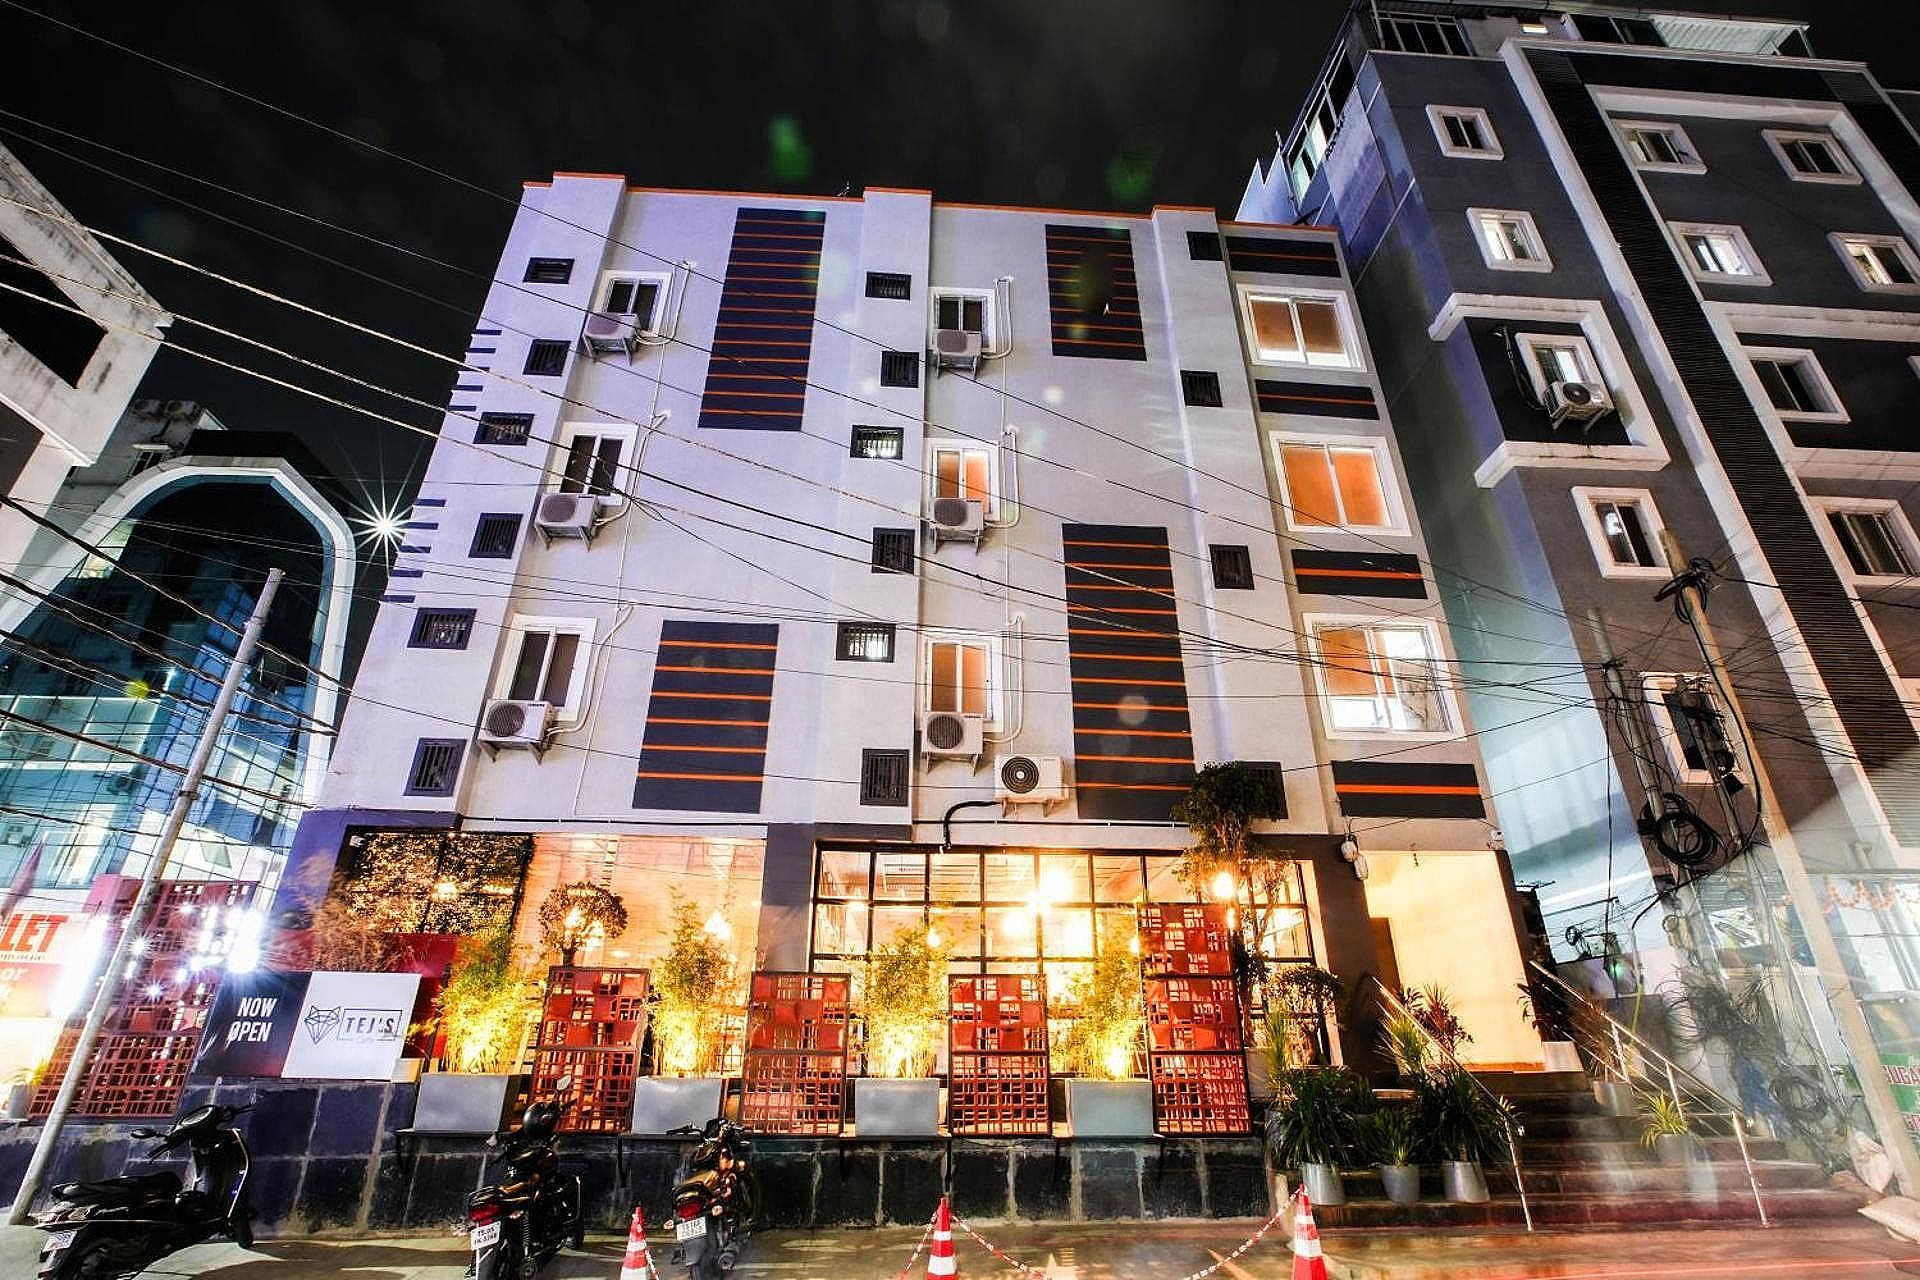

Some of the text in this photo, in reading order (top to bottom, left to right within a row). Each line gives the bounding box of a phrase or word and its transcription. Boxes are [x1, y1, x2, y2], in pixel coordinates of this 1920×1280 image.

[237, 997, 277, 1018] NOW
[227, 1021, 273, 1045] OPEN
[345, 1016, 395, 1034] TEJ'S
